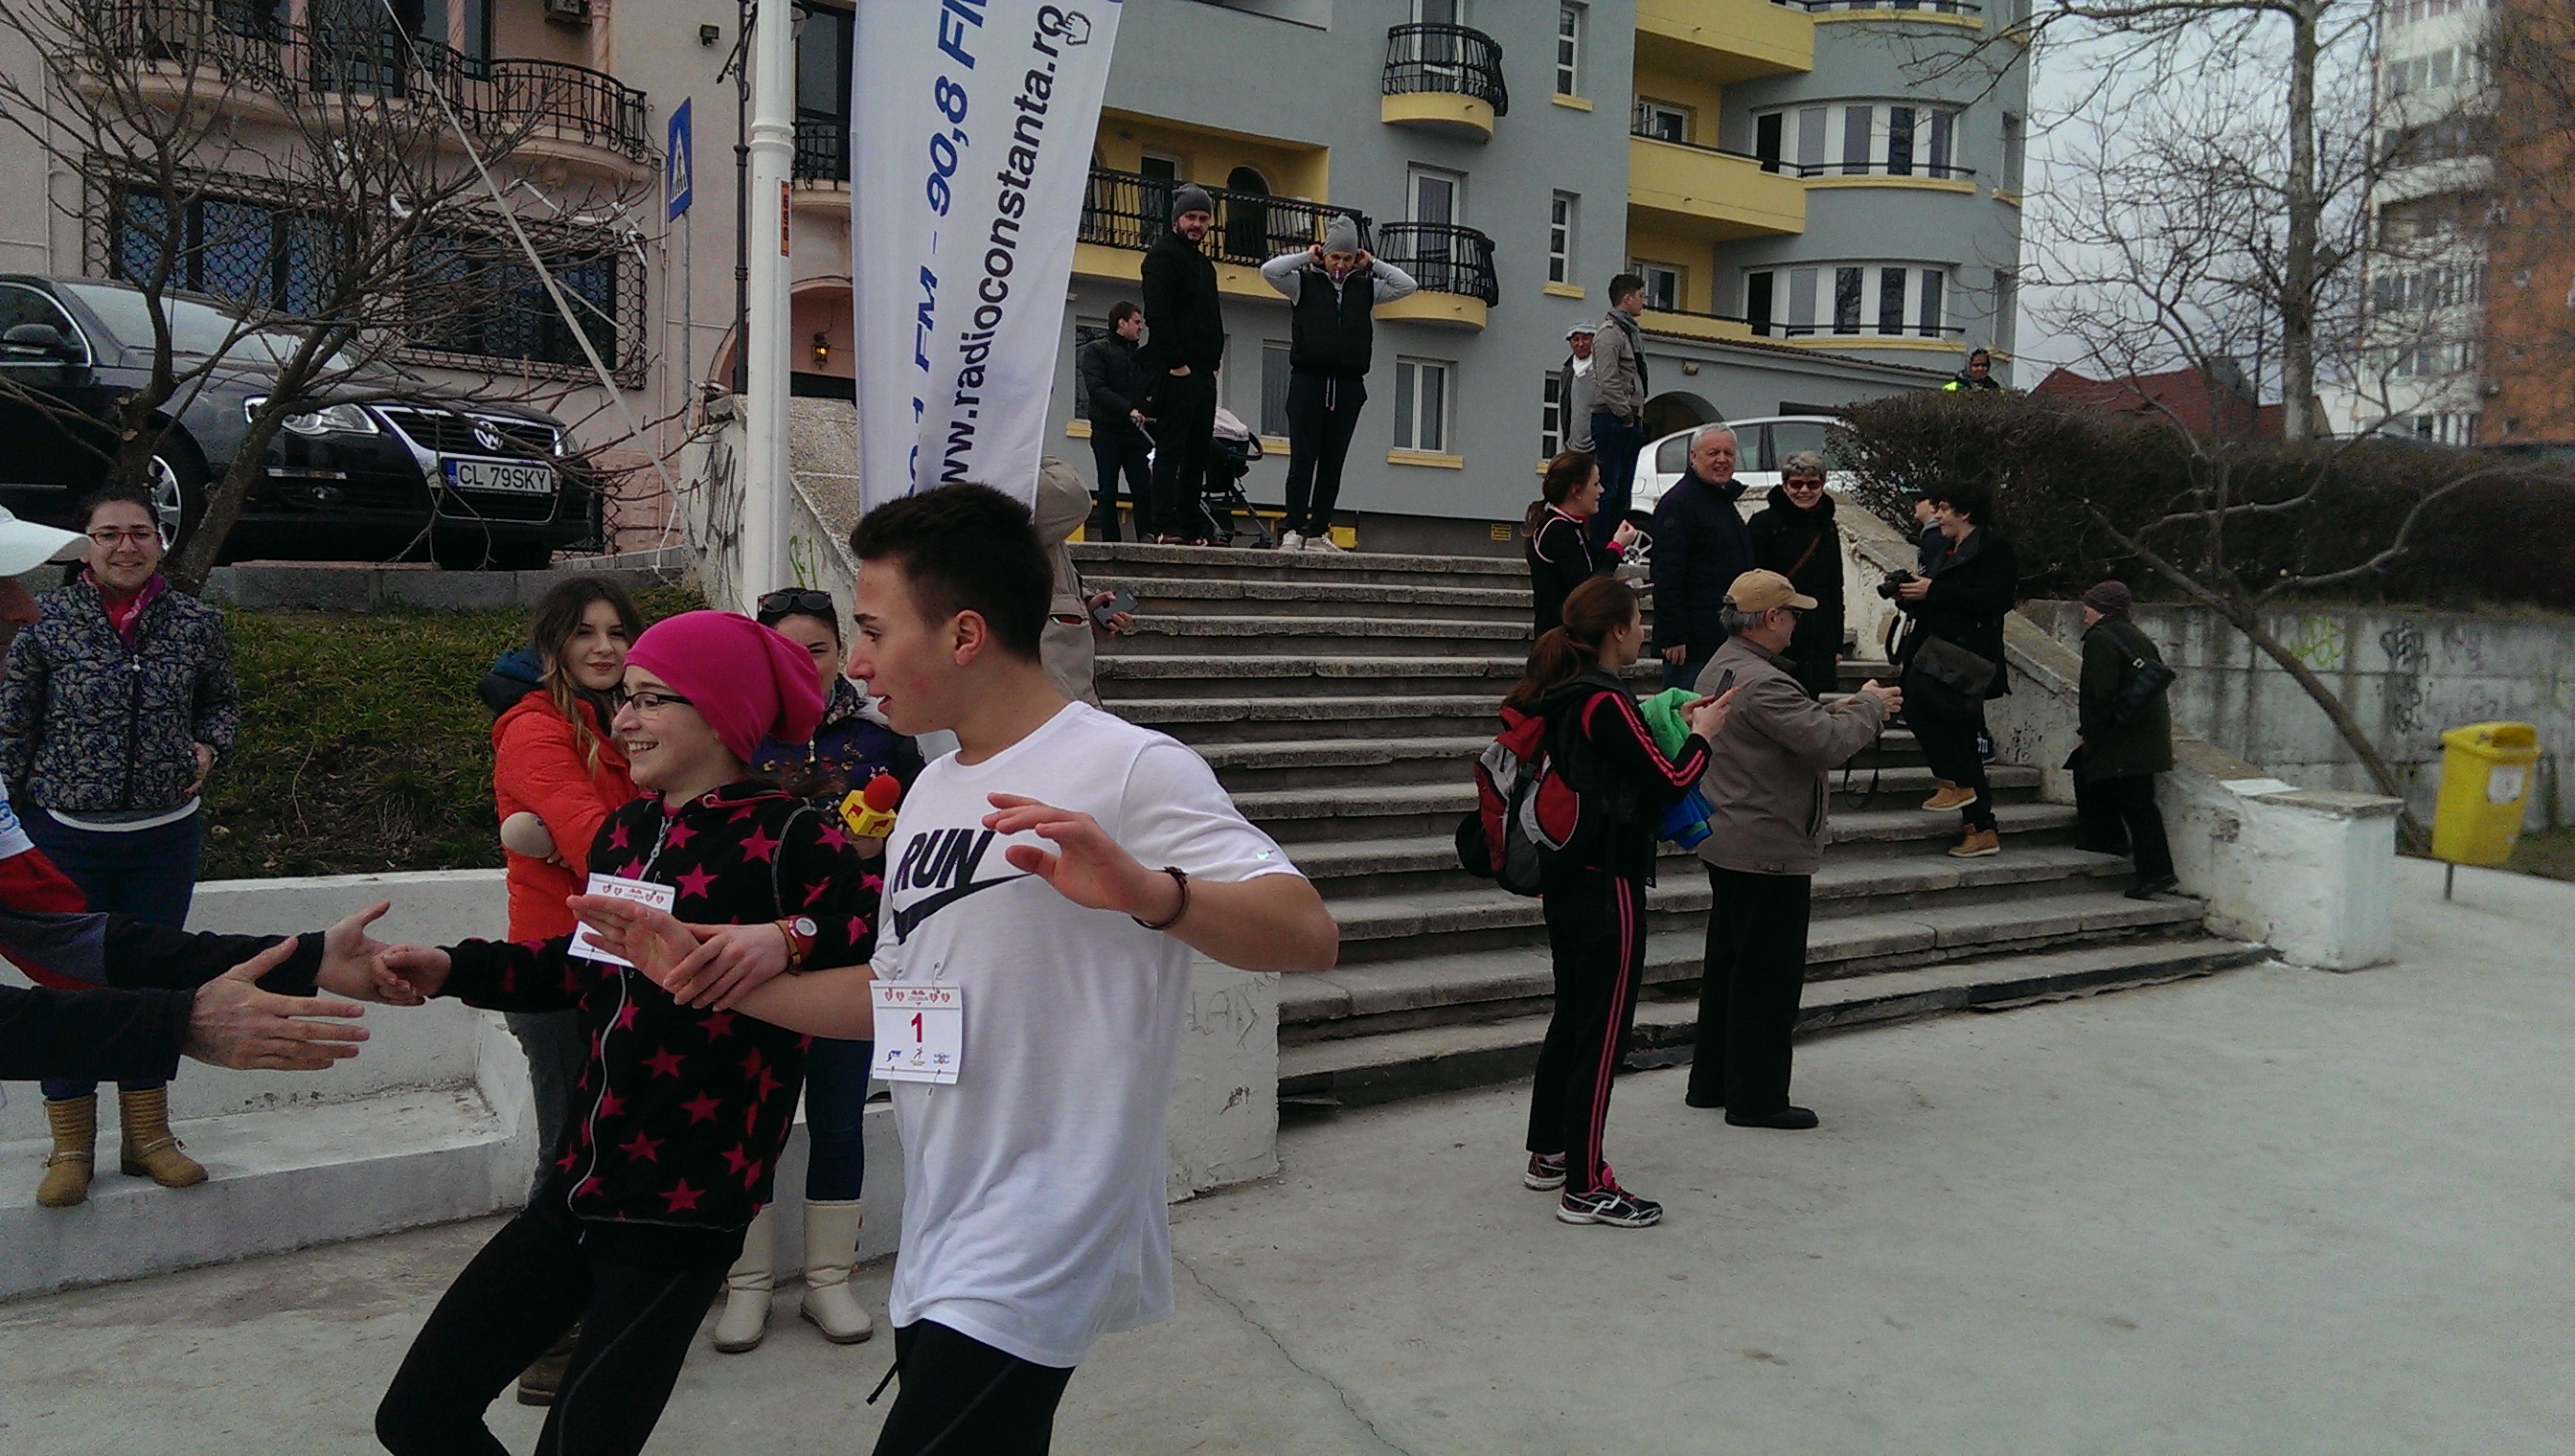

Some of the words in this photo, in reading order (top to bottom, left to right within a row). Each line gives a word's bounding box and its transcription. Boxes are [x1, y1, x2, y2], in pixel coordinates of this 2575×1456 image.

[926, 75, 970, 217] 90,8
[941, 4, 1064, 483] ww.radioconstanta.ro
[460, 465, 485, 486] CL
[490, 466, 547, 490] 79SKY
[893, 828, 997, 893] RUN
[910, 1012, 923, 1043] 1
